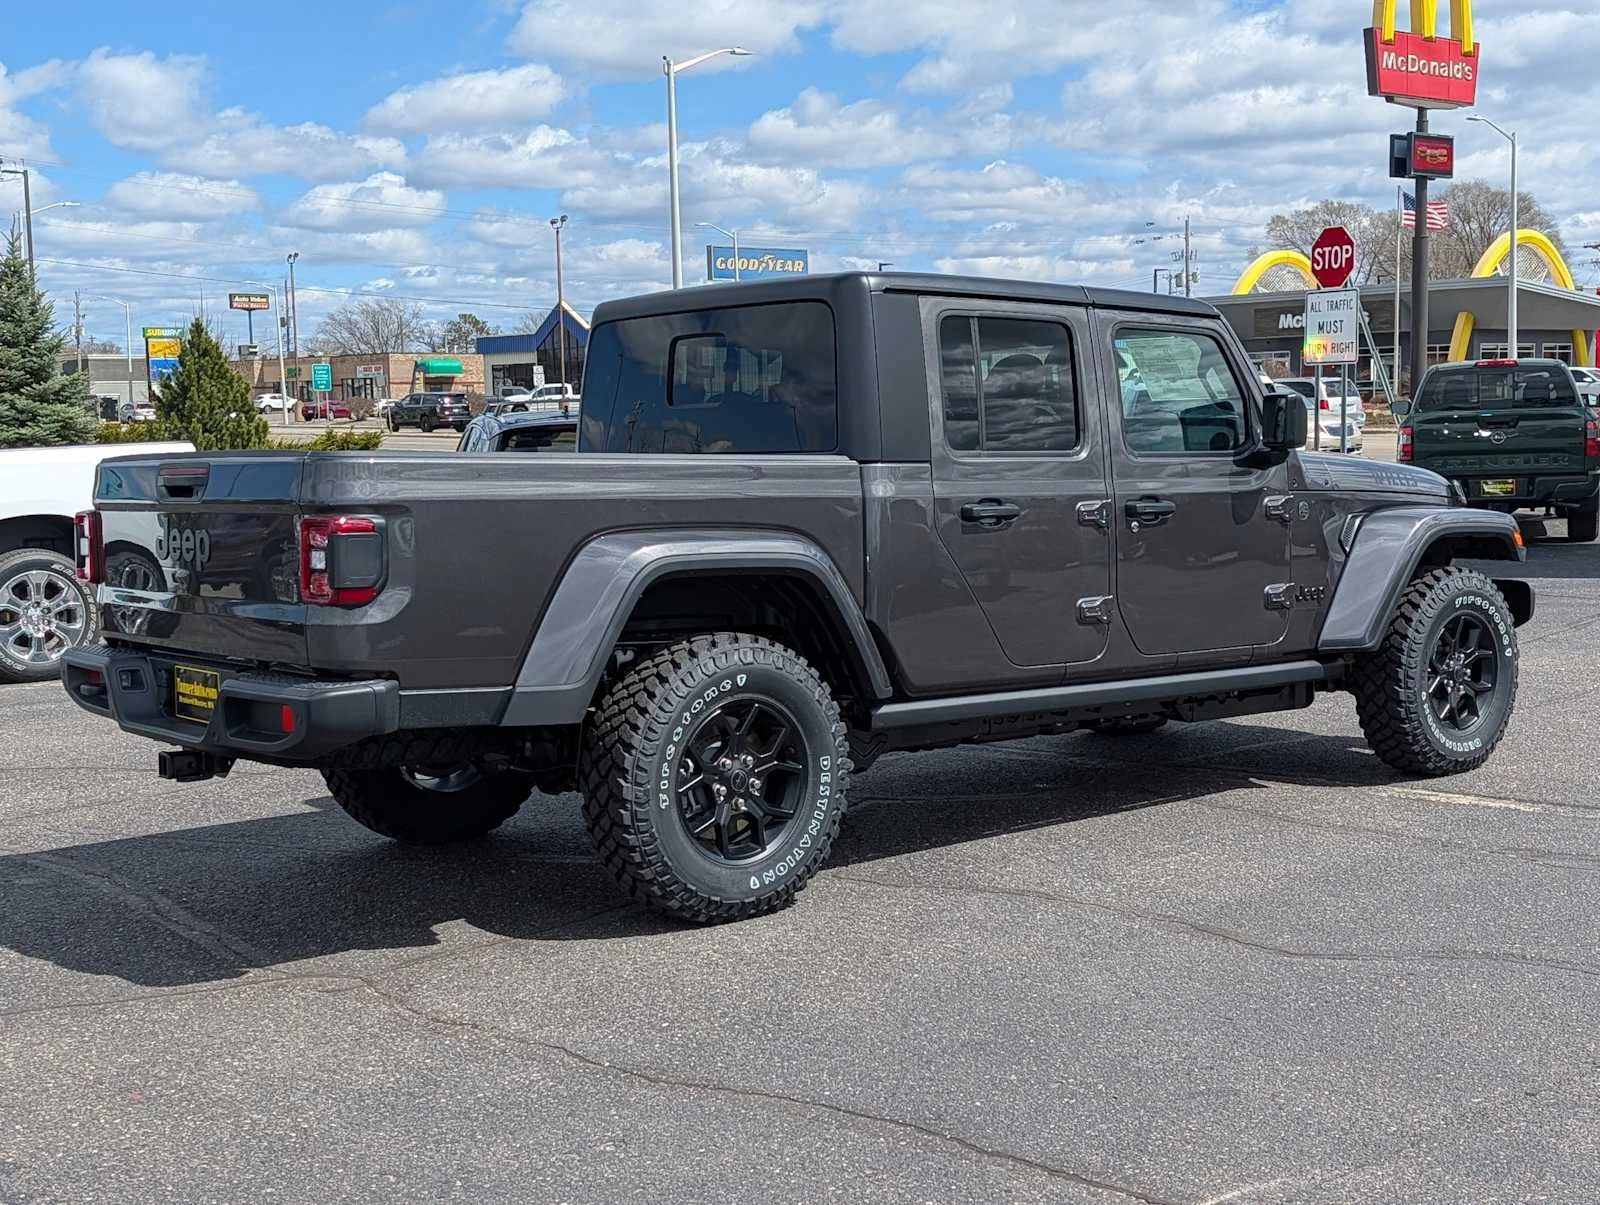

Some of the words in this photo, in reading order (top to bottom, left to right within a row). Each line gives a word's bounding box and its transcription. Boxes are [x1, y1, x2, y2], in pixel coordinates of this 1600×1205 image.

[1382, 51, 1473, 80] McDonald's
[715, 255, 805, 273] GOODYEAR
[1313, 244, 1352, 270] STOP
[1310, 301, 1322, 313] ALL
[1326, 298, 1353, 312] TRAFFIC
[145, 327, 183, 337] SUBWAY
[1317, 319, 1345, 334] MUST
[1308, 343, 1328, 355] TURN
[1331, 341, 1355, 354] RIGHT
[155, 512, 211, 572] Jeep
[1423, 703, 1483, 752] DESTINATION
[763, 755, 831, 884] DESTINATION
